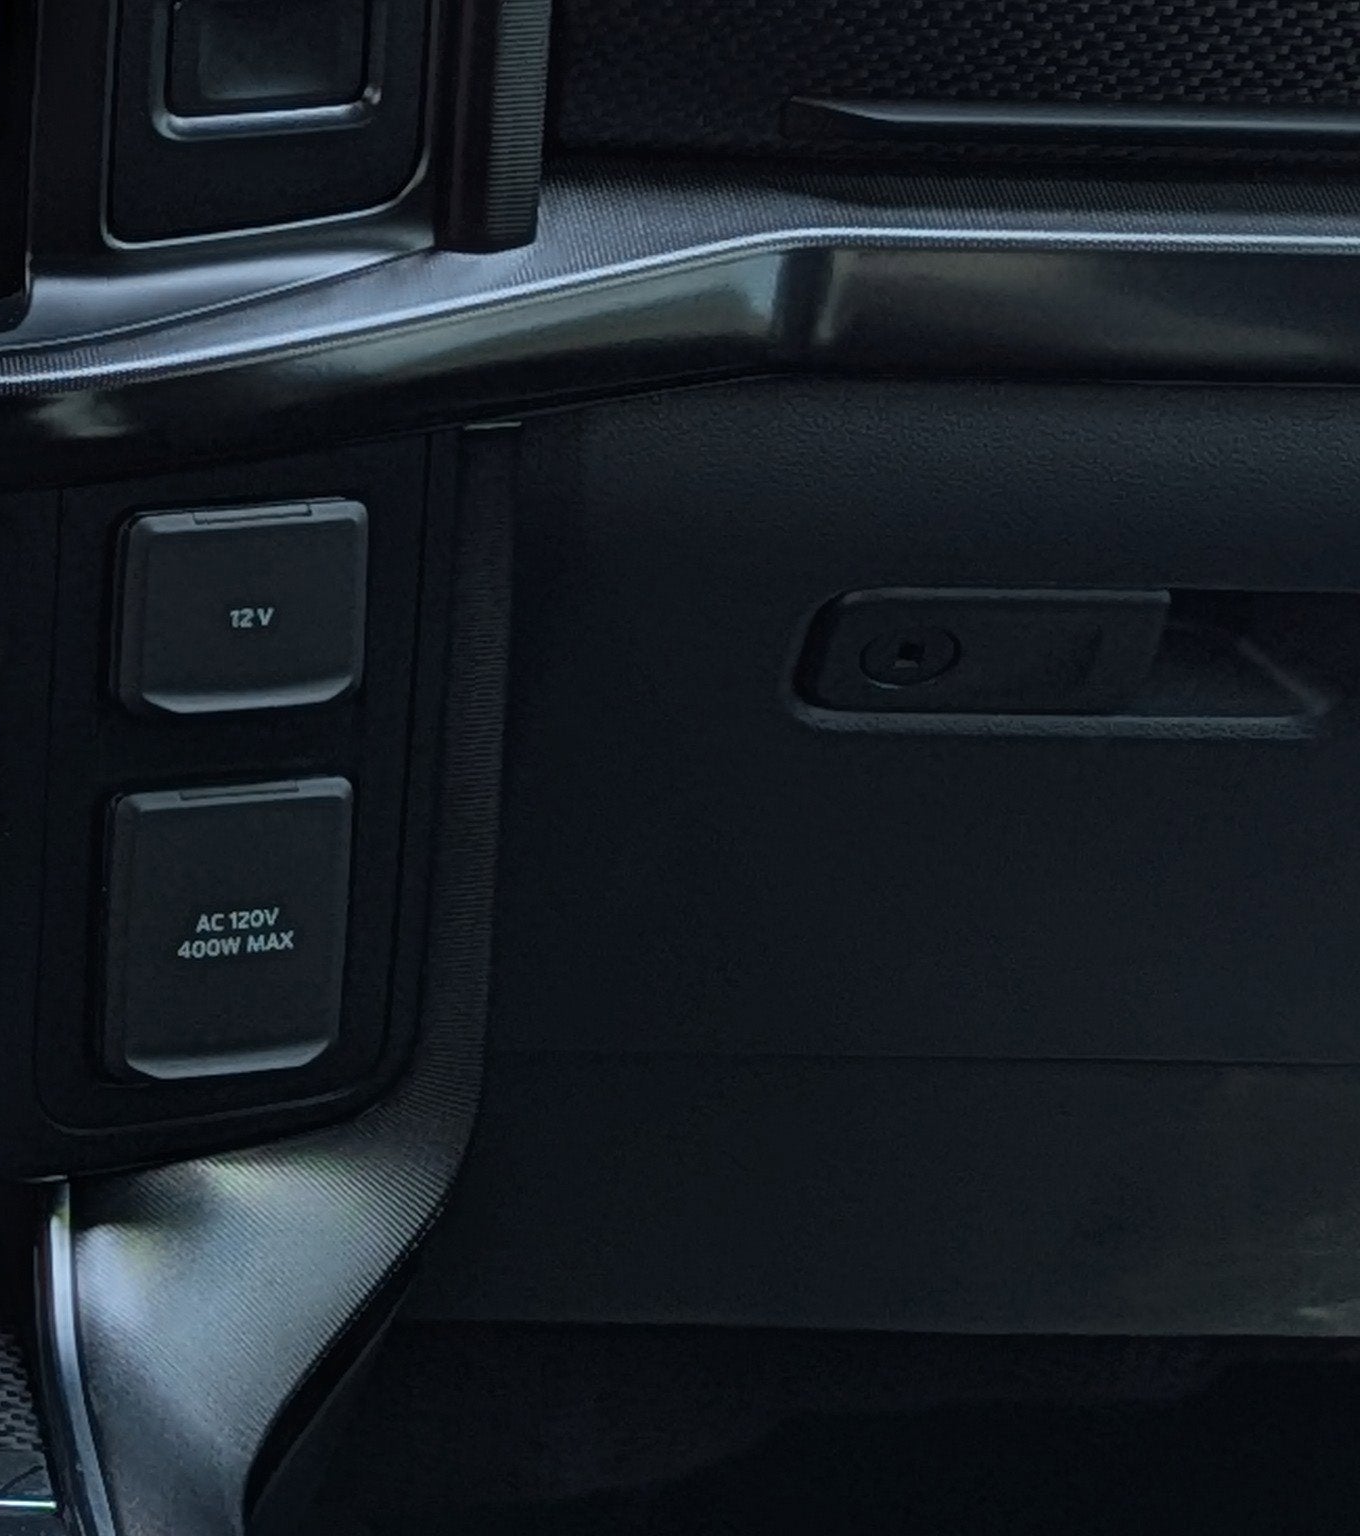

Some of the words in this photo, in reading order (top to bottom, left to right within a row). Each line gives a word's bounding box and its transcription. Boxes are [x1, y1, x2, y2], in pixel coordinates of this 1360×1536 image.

[195, 913, 226, 933] AC
[229, 907, 280, 931] 120V
[178, 937, 241, 959] 400W
[246, 931, 294, 952] MAX
